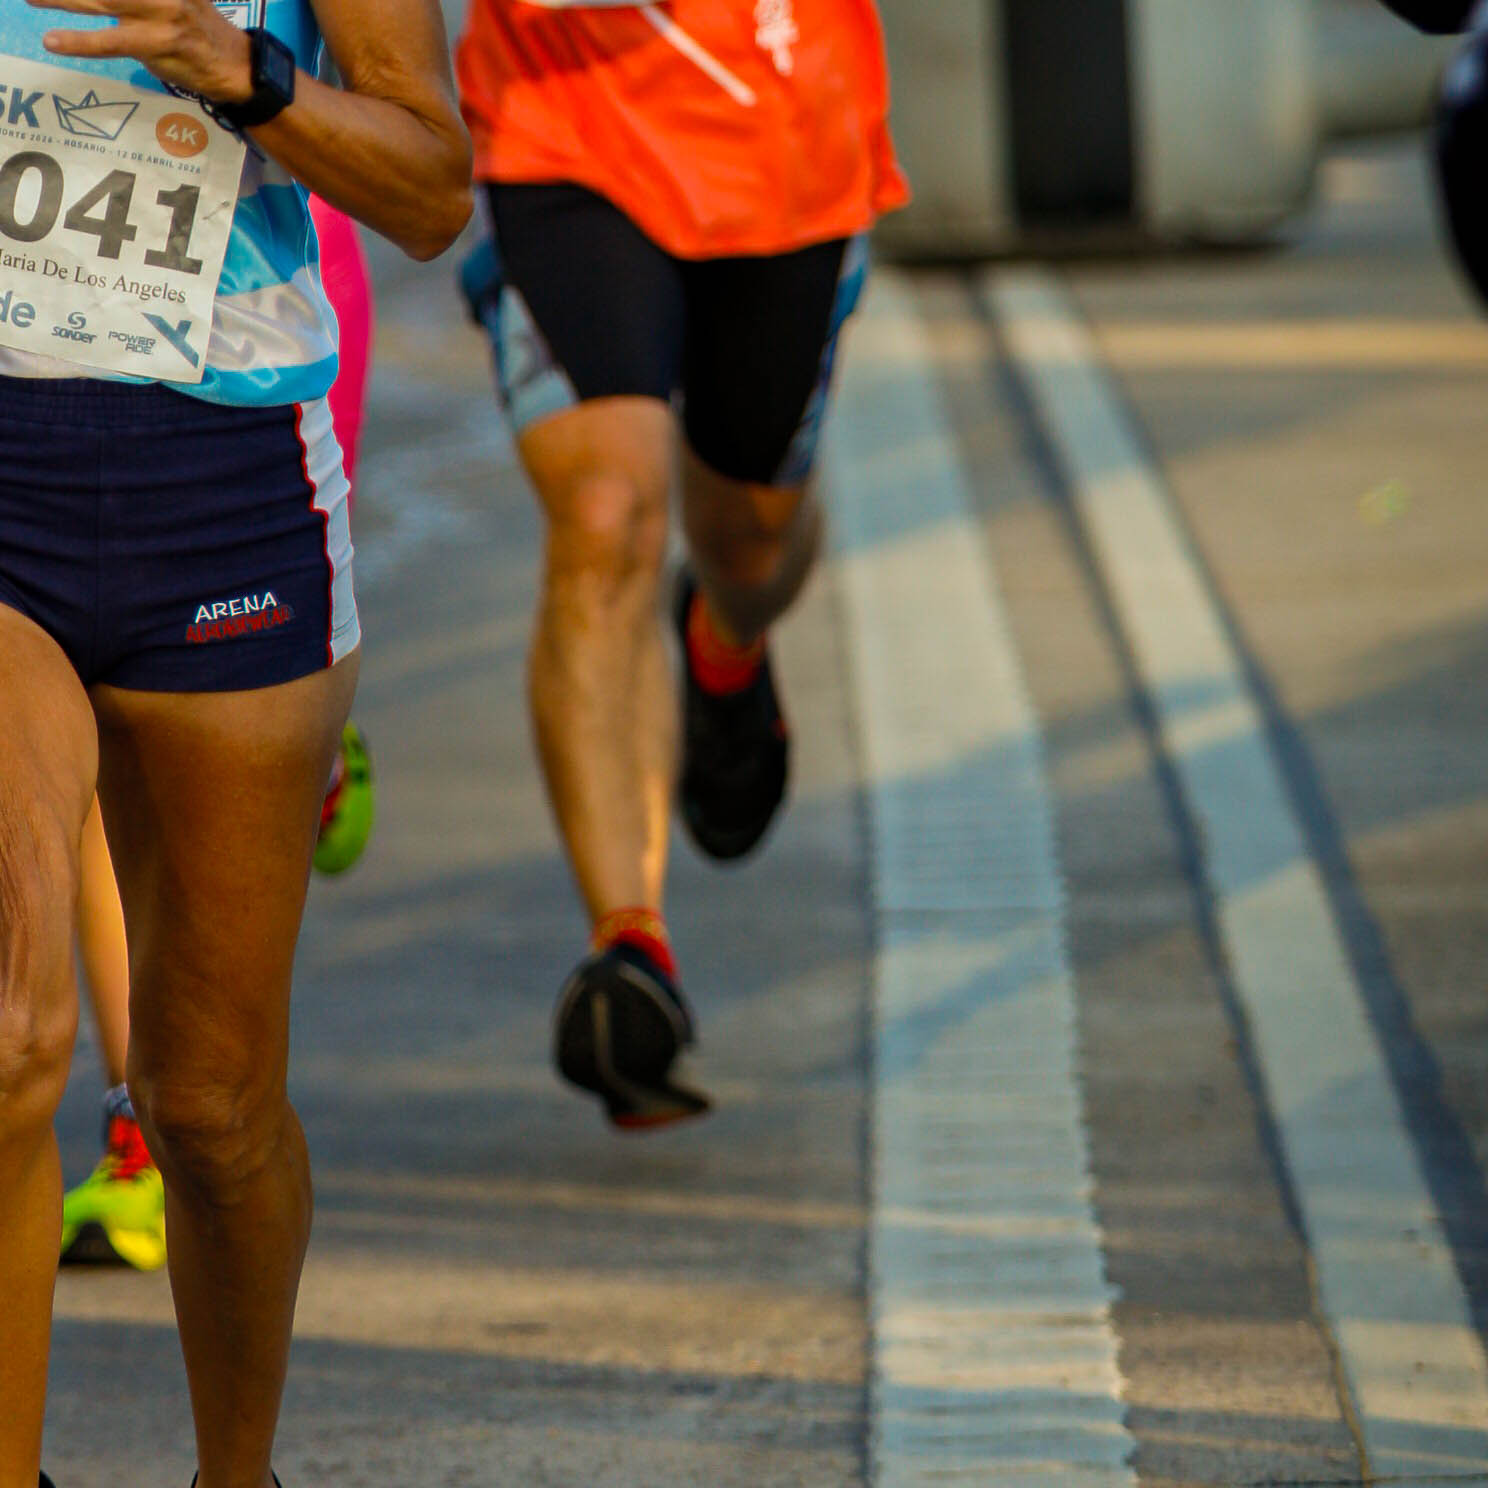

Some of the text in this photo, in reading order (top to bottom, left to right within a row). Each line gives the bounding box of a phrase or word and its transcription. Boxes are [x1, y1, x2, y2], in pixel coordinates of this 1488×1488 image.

[165, 123, 200, 146] 4K
[63, 138, 106, 154] ROSARIO
[131, 151, 143, 162] DE
[146, 156, 174, 170] ABRIL
[42, 258, 69, 280] De
[73, 264, 108, 289] Los
[111, 275, 188, 305] Angeles
[107, 330, 157, 347] POWER
[194, 591, 278, 624] ARENA
